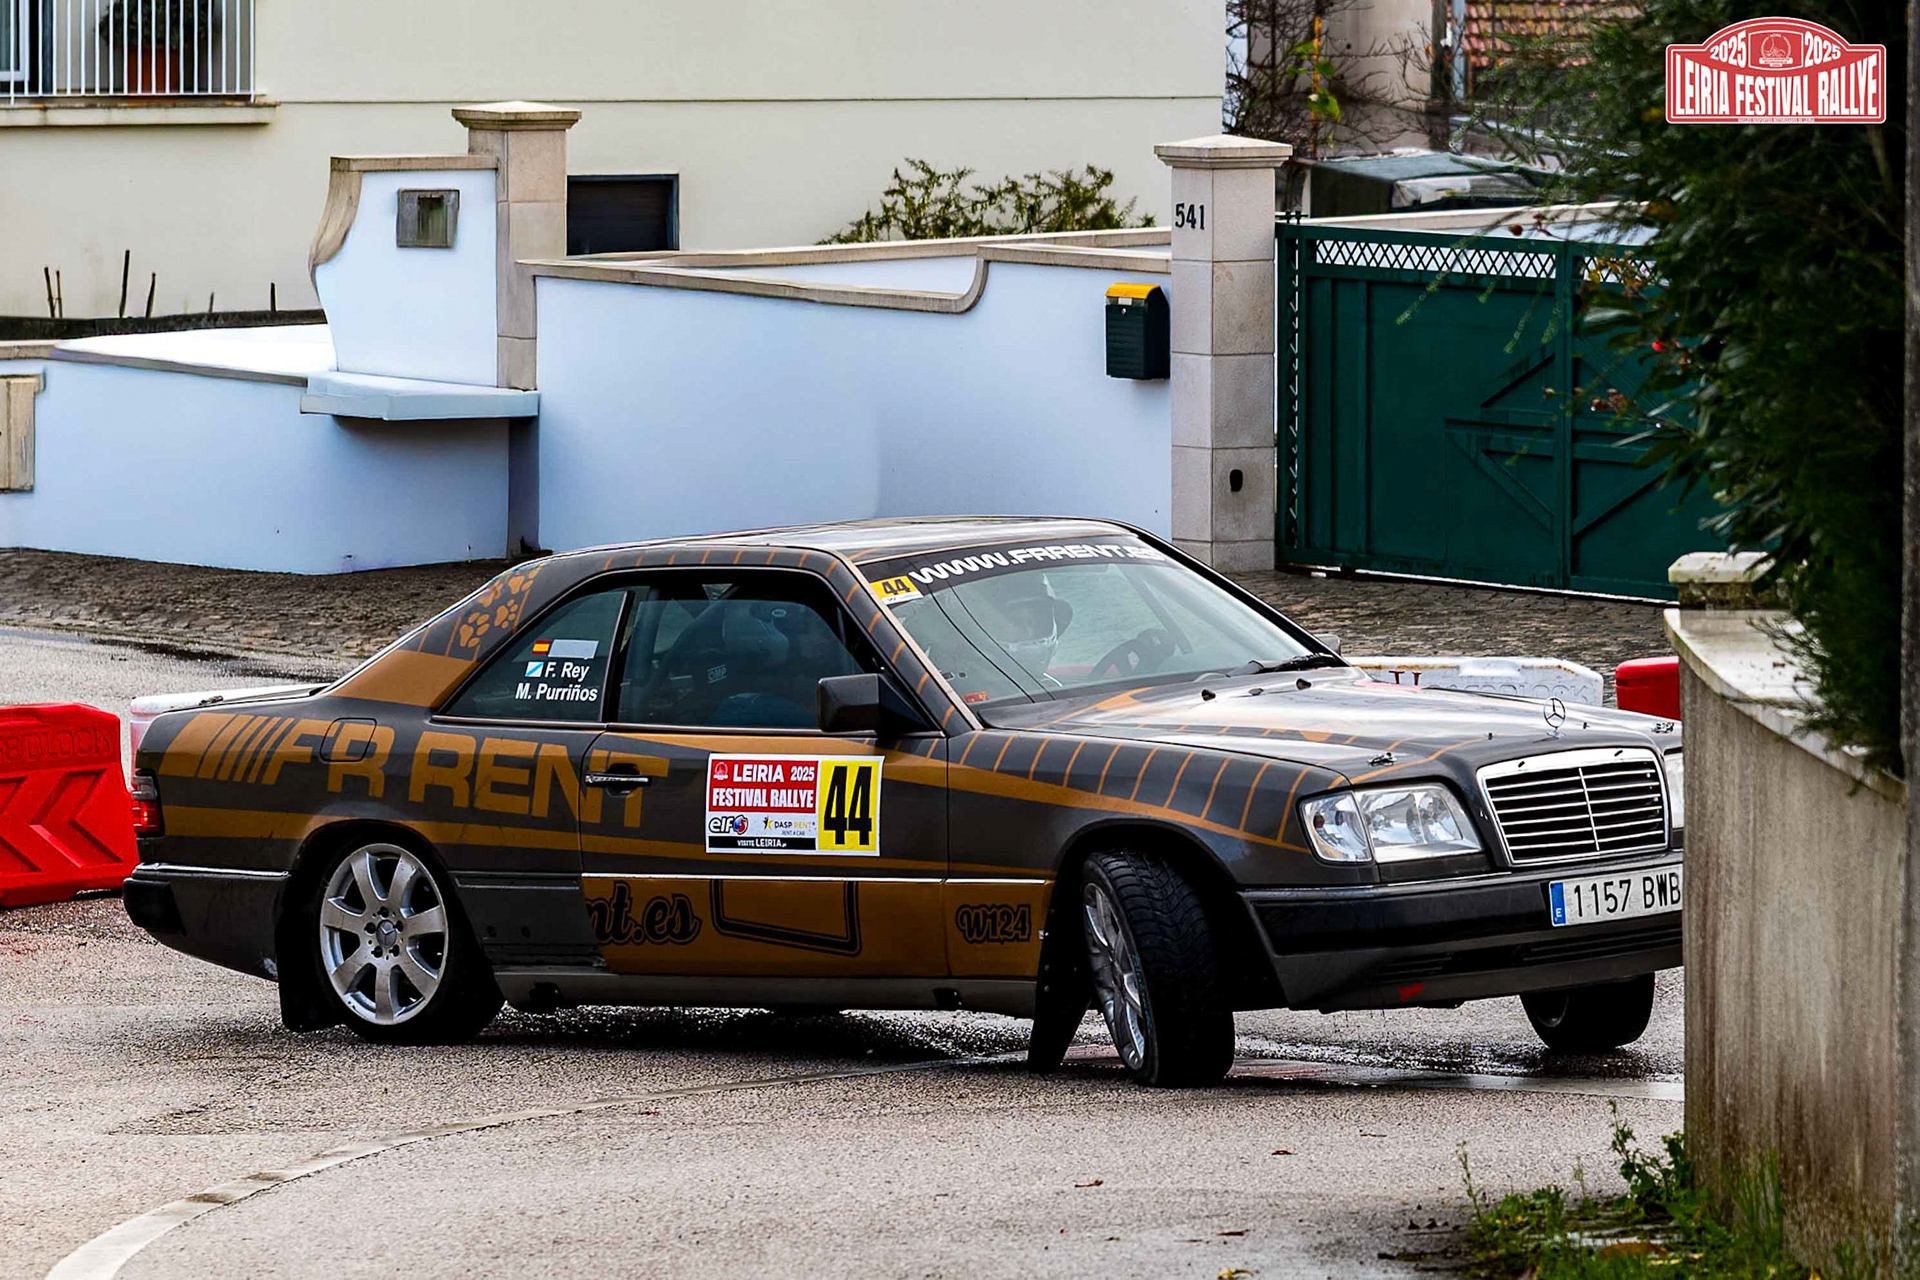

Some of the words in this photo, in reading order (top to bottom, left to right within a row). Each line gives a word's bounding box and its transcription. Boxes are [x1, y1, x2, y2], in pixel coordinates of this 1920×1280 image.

[1174, 203, 1205, 230] 541
[882, 579, 911, 595] 44
[544, 662, 556, 678] F.
[561, 662, 590, 682] Rey
[515, 683, 532, 700] M.
[536, 683, 598, 702] Purriños
[261, 717, 395, 799] FR
[408, 731, 670, 829] RENT
[733, 763, 785, 783] LEIRIA
[790, 765, 815, 782] 2025
[712, 788, 768, 808] FESTIVAL
[770, 789, 814, 809] RALLYE
[824, 765, 872, 846] 44
[709, 816, 734, 833] elf
[737, 839, 755, 847] VISITE
[1556, 907, 1562, 917] E
[1574, 878, 1631, 918] 1157
[1642, 872, 1682, 909] BWB
[956, 903, 1031, 944] W124
